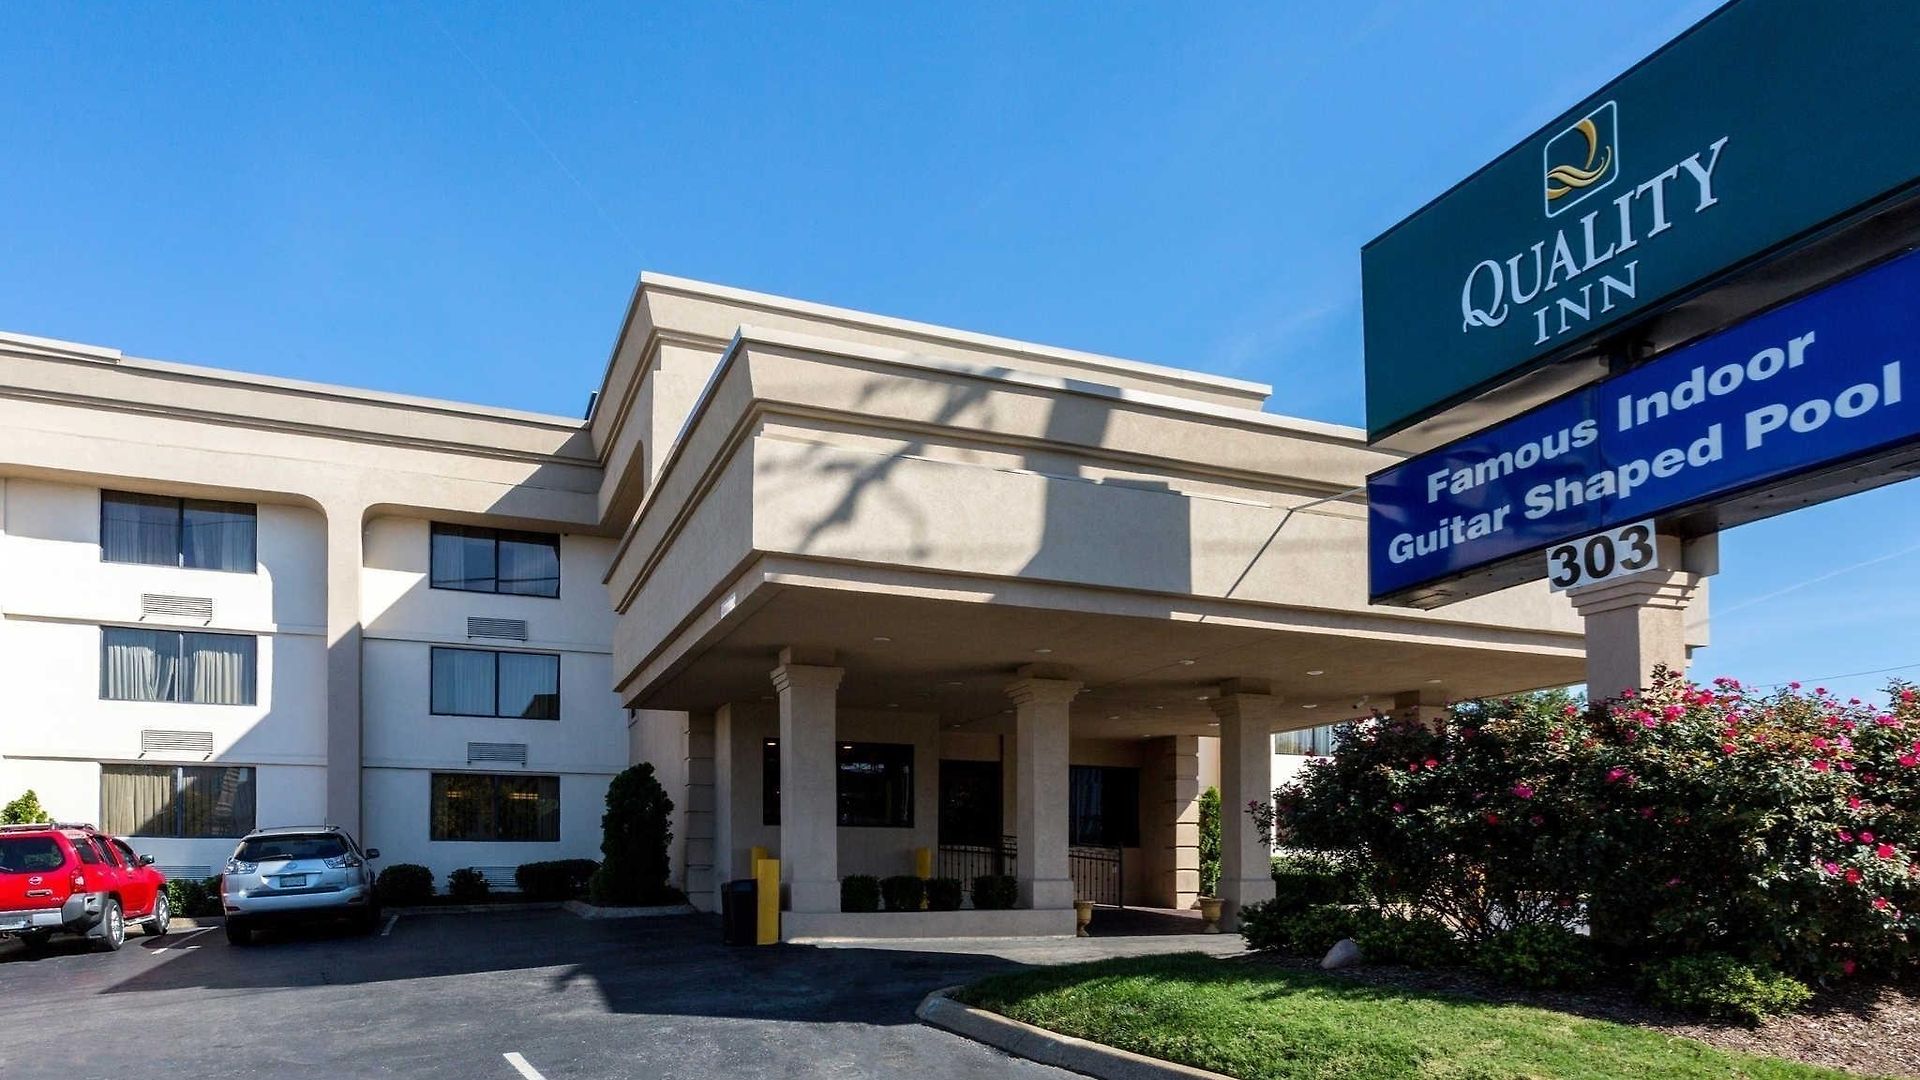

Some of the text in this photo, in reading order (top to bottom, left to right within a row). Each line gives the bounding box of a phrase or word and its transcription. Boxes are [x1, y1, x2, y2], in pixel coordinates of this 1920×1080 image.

[1461, 136, 1729, 333] QUALITY
[1534, 260, 1639, 346] INN
[1388, 360, 1902, 564] Guitar Shaped Pool
[1427, 331, 1816, 503] Famous Indoor
[1550, 525, 1654, 588] 303
